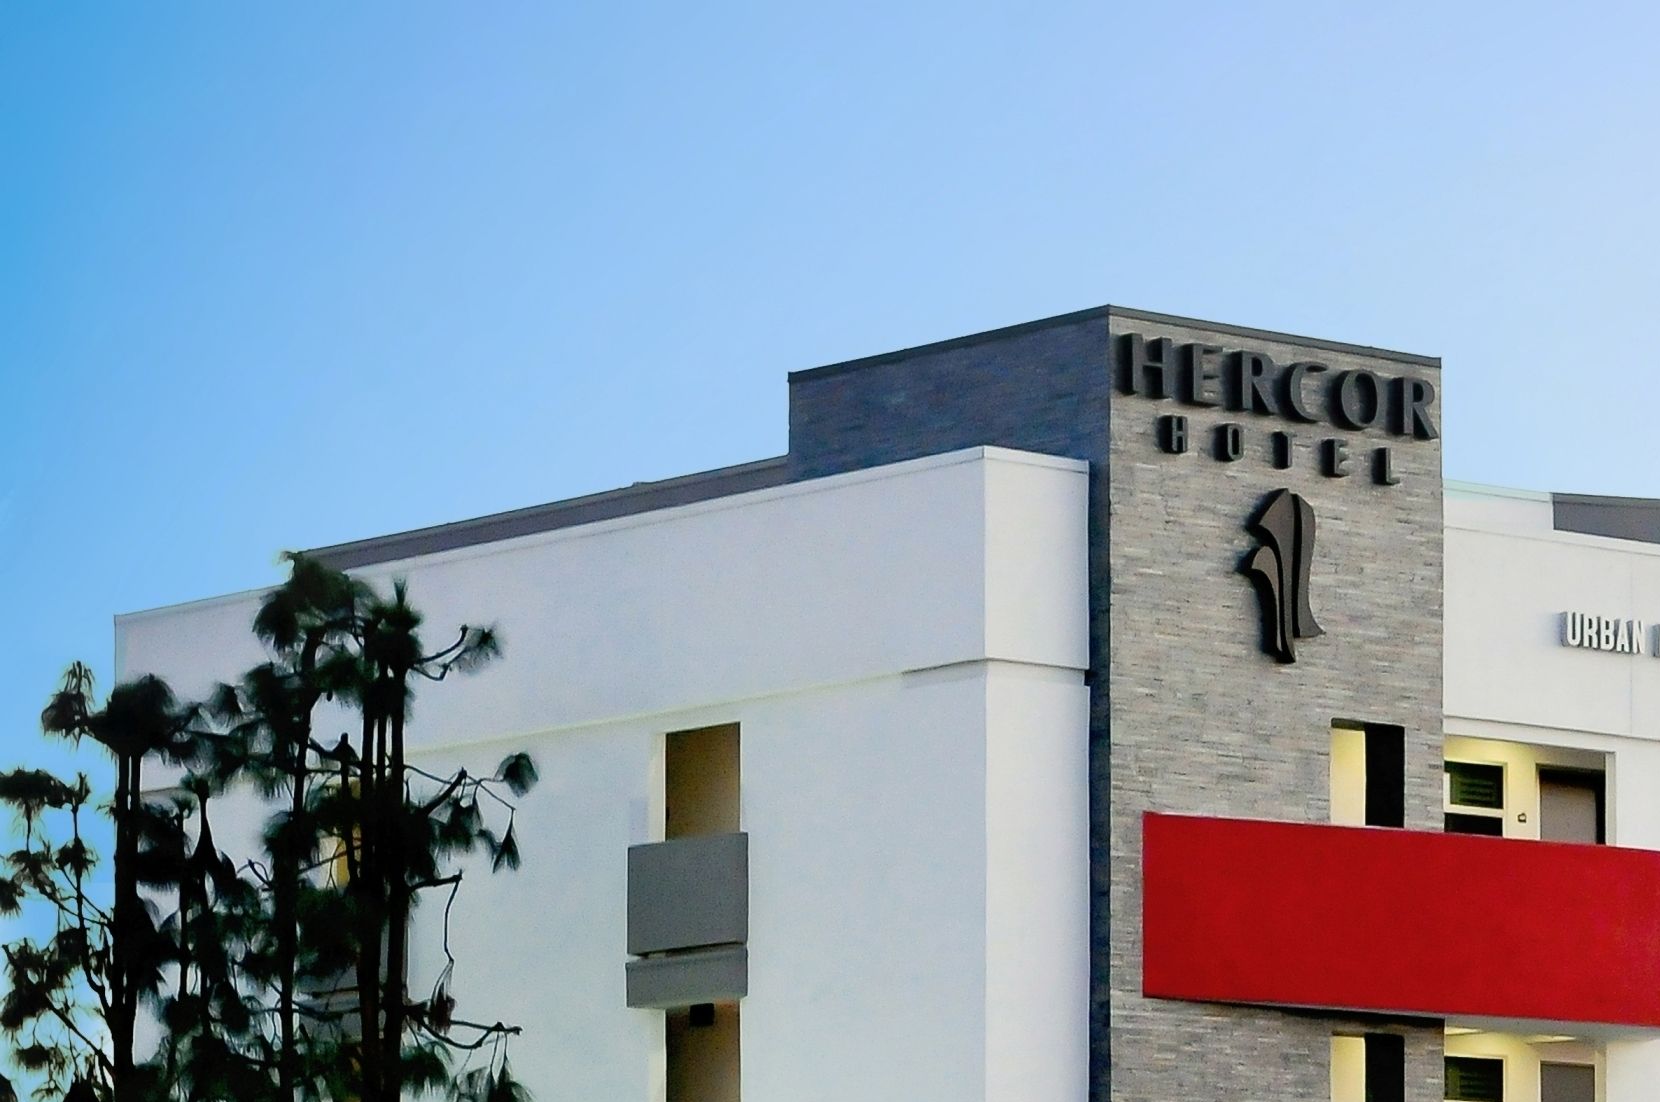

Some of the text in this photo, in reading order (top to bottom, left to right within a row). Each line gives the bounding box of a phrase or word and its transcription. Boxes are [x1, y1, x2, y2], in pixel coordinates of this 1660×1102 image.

[1114, 332, 1438, 440] HERCOR
[1159, 414, 1401, 486] HOTEL
[1561, 611, 1645, 655] URBAN
